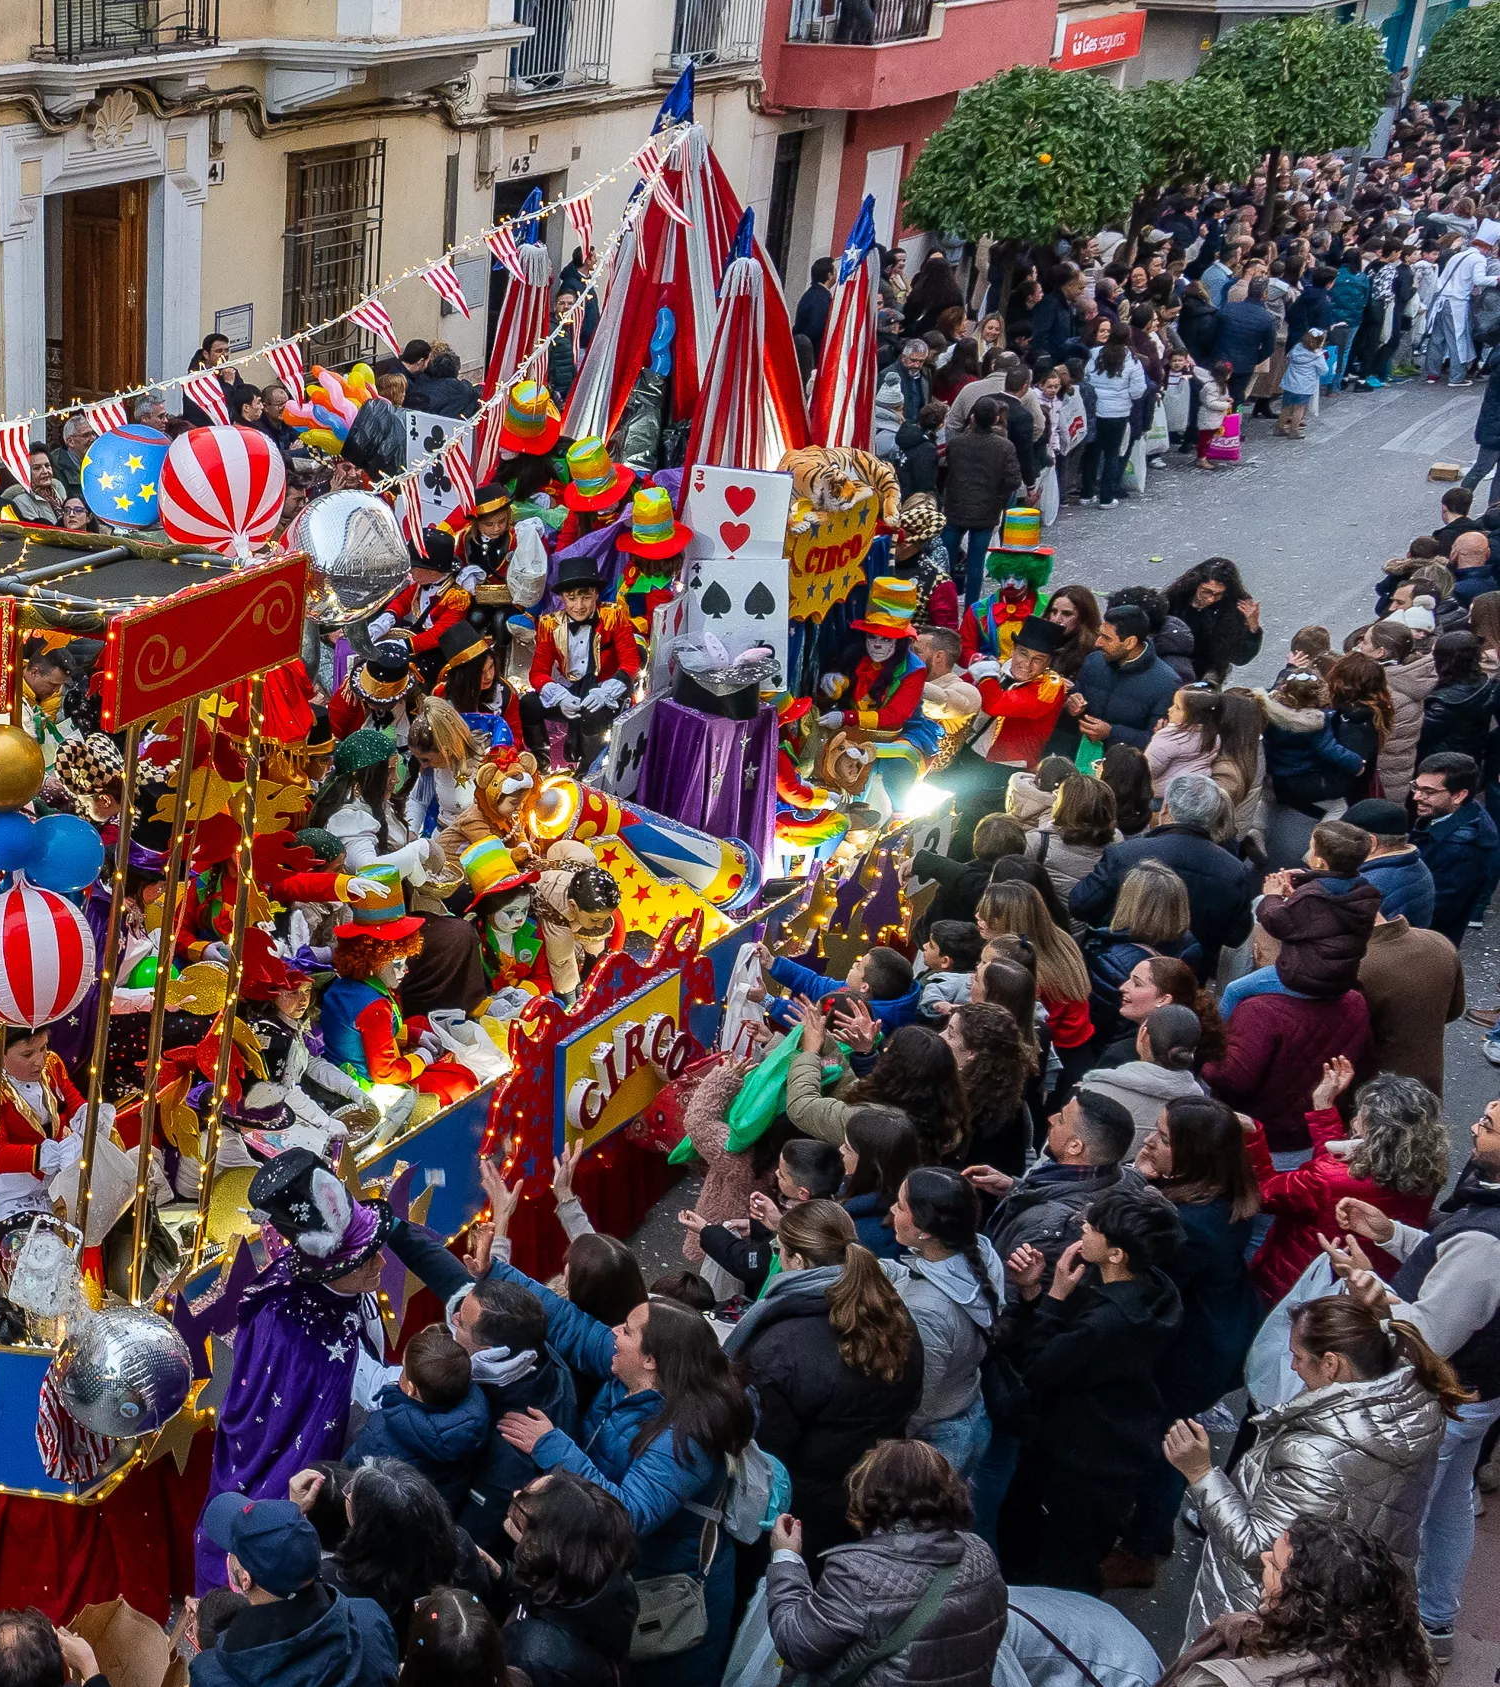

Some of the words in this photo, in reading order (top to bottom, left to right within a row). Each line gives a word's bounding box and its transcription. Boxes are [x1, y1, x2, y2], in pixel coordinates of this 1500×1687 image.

[1082, 35, 1098, 53] Ges
[1097, 32, 1127, 54] seguros
[208, 162, 225, 182] 41
[511, 156, 530, 174] 43
[410, 415, 417, 426] 3
[696, 470, 706, 481] 3
[804, 533, 863, 576] CIRCO
[691, 562, 702, 574] 4
[568, 1012, 692, 1131] CIRCO
